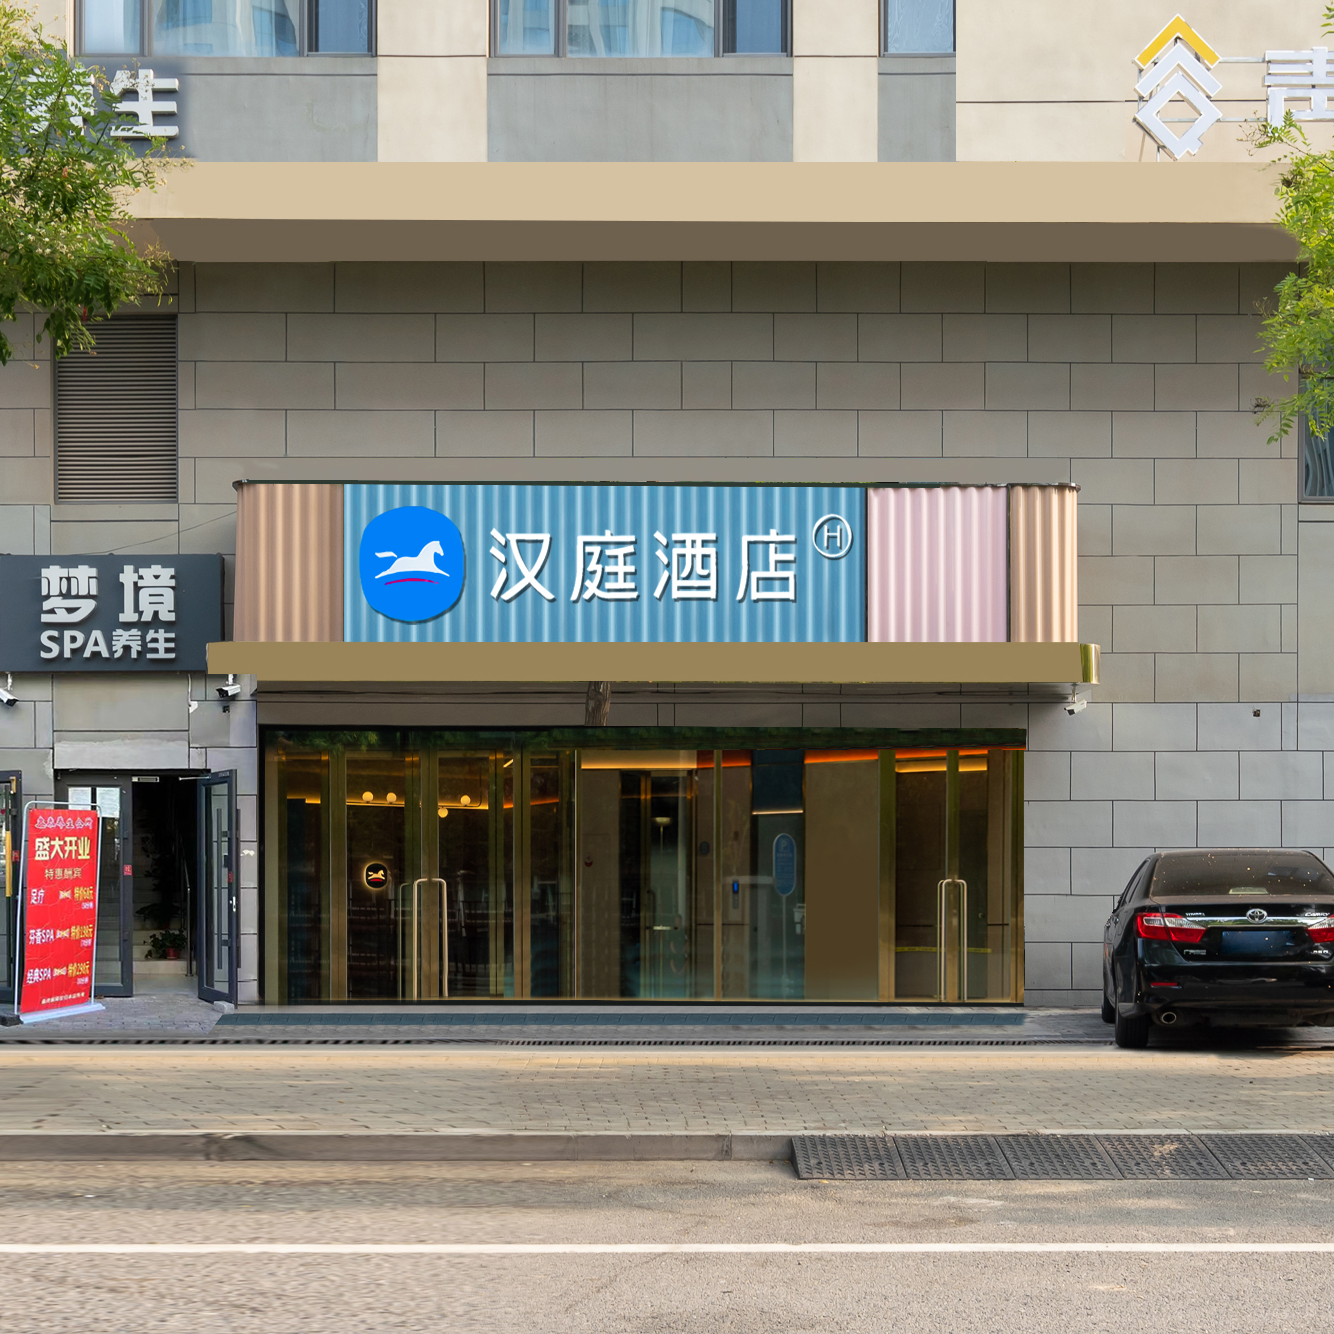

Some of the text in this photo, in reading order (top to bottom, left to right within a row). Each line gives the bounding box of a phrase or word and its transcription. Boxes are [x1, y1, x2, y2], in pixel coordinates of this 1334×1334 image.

[489, 527, 798, 604] 汉庭酒店
[40, 564, 176, 624] 梦境
[40, 627, 176, 660] SPA养生
[34, 836, 91, 861] 盛大开业
